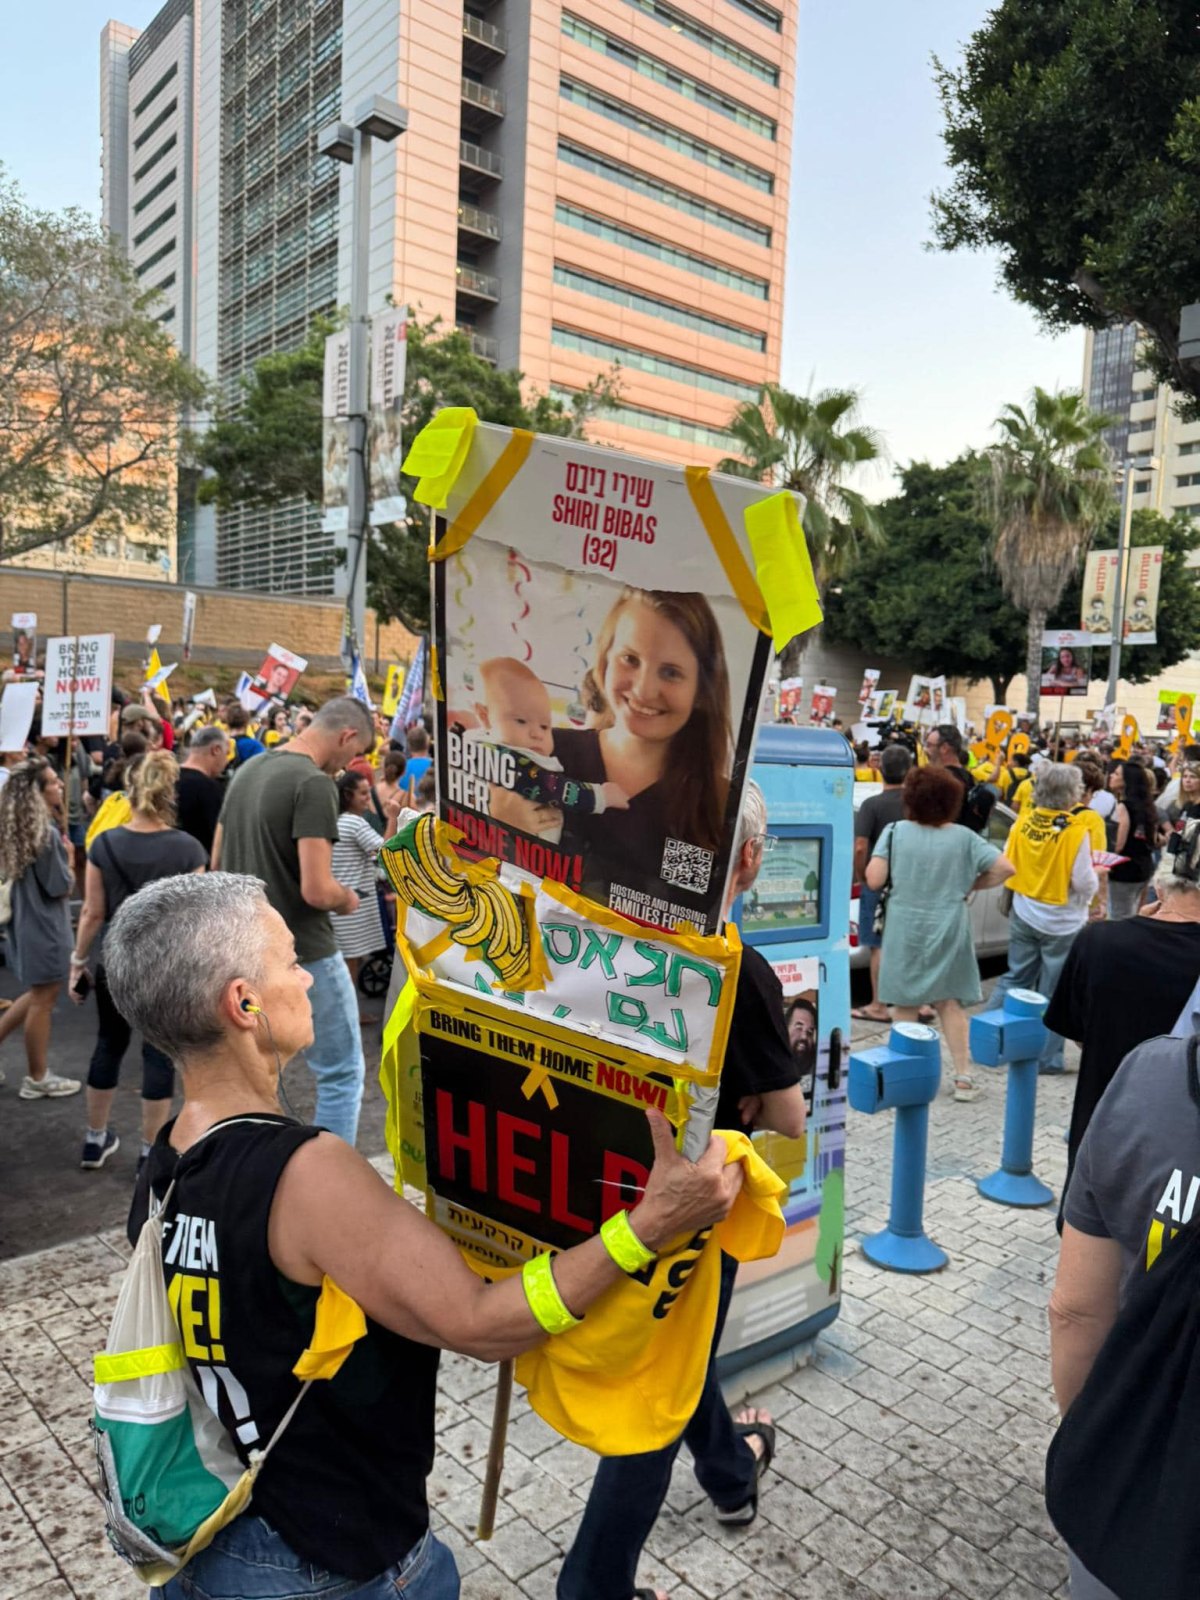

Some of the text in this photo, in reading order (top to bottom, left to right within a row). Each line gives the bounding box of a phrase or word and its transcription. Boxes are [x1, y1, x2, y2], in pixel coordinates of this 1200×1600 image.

[566, 461, 654, 508] שירי ביבס
[552, 494, 657, 545] SHIRI BIBAS
[582, 532, 617, 572] (32)
[58, 641, 99, 654] BRING
[56, 677, 101, 693] NOW!
[447, 731, 516, 790] BRING
[448, 768, 490, 816] HER
[447, 806, 584, 893] HOME NOW!
[609, 894, 706, 937] FAMILIES FOM
[610, 882, 708, 924] HOSTAGES AND MISSING
[430, 1009, 668, 1112] BRING THEM HOME NOW!
